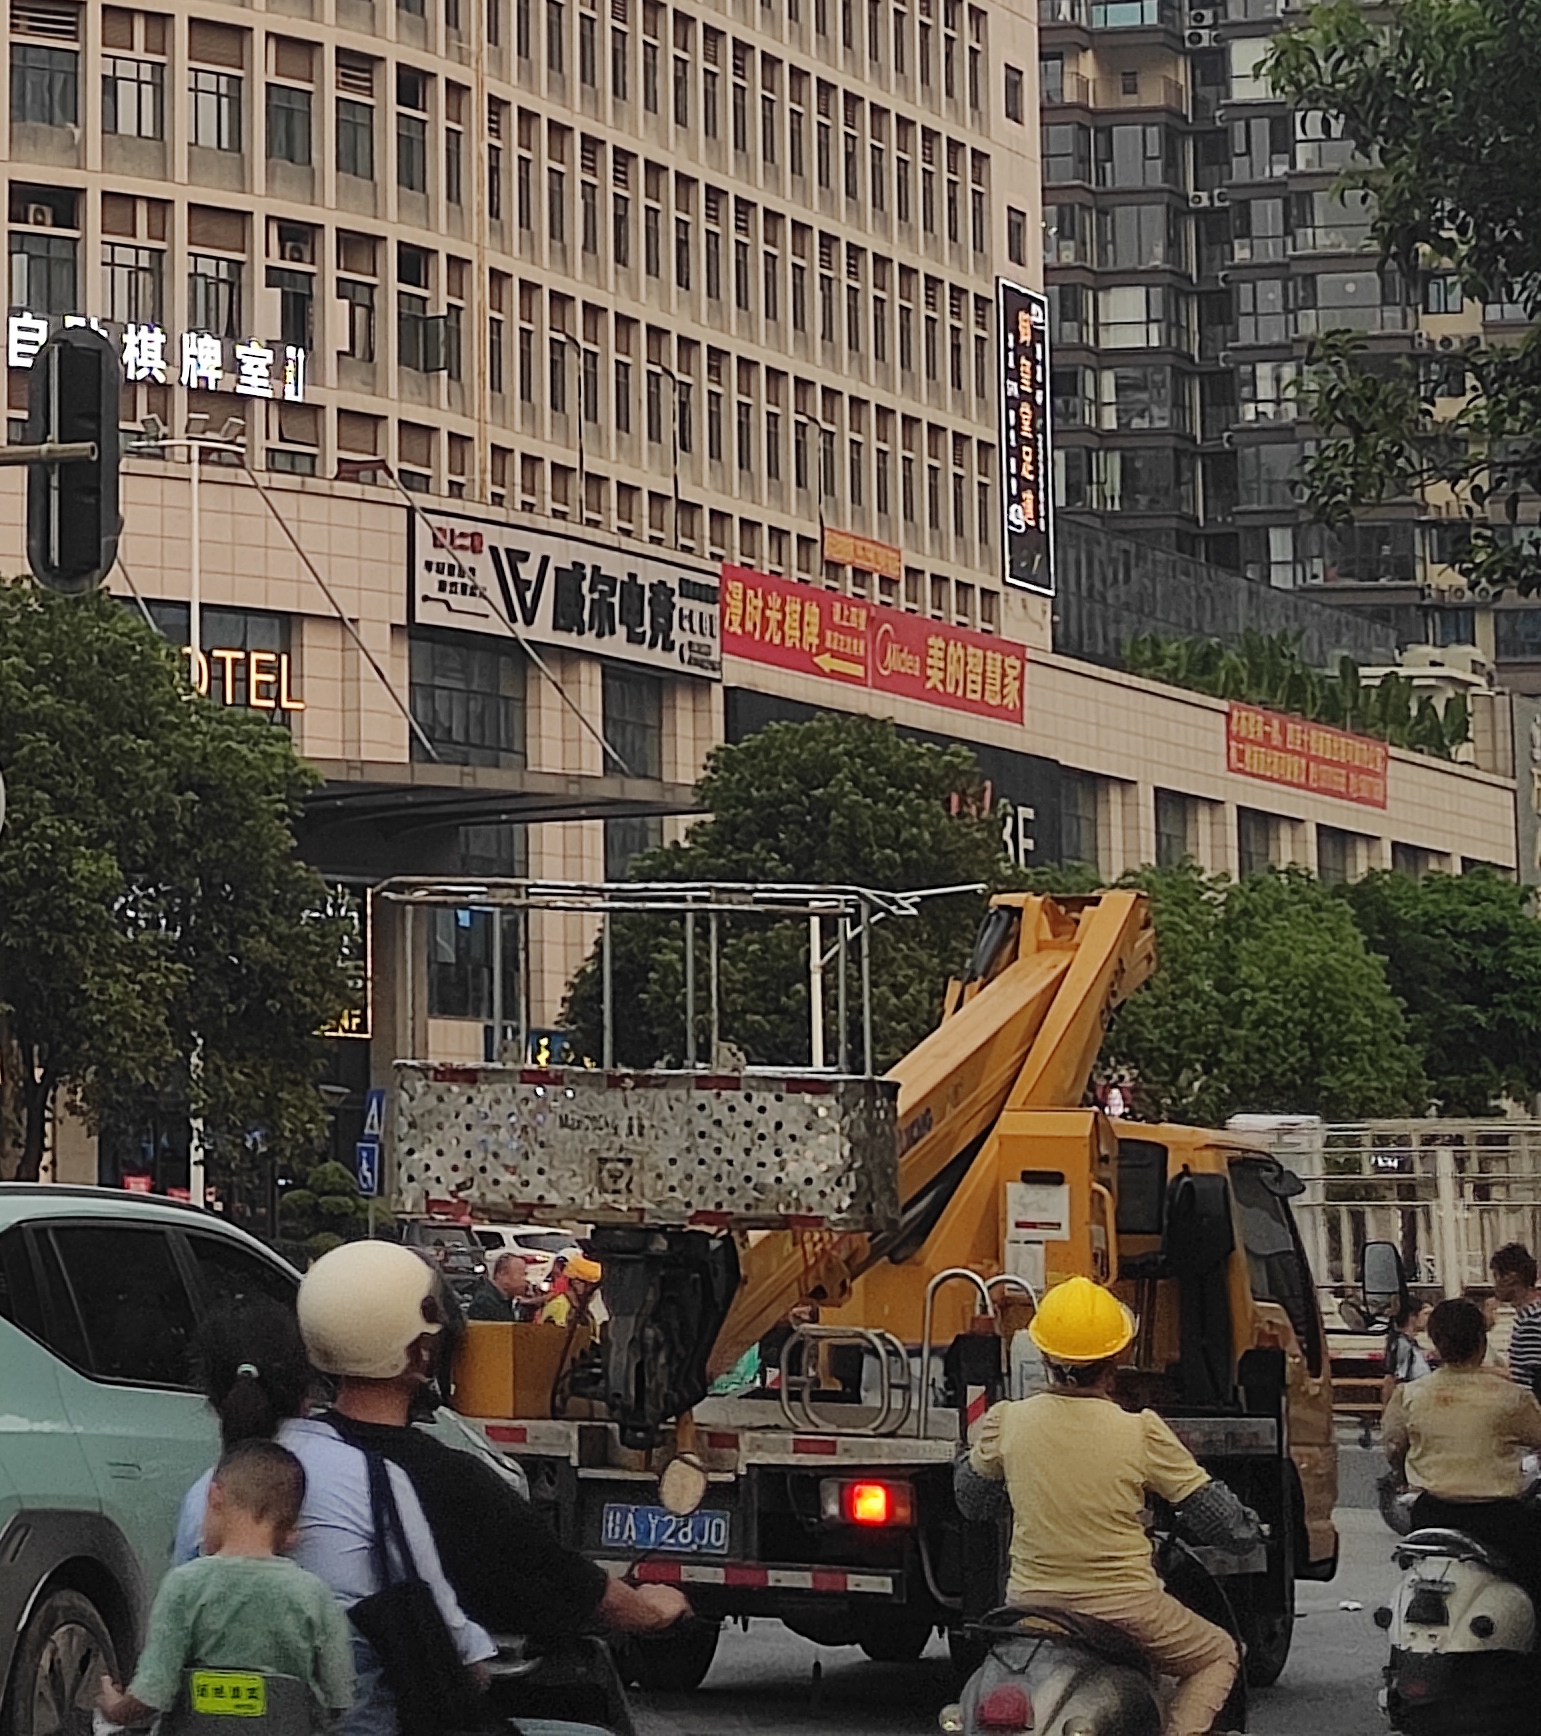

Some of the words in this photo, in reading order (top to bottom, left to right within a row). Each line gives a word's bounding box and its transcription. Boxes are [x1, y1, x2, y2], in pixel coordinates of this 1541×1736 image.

[552, 560, 676, 652] 威尔电竞
[723, 579, 821, 654] 漫时光棋牌
[925, 634, 1022, 711] 美的智慧家
